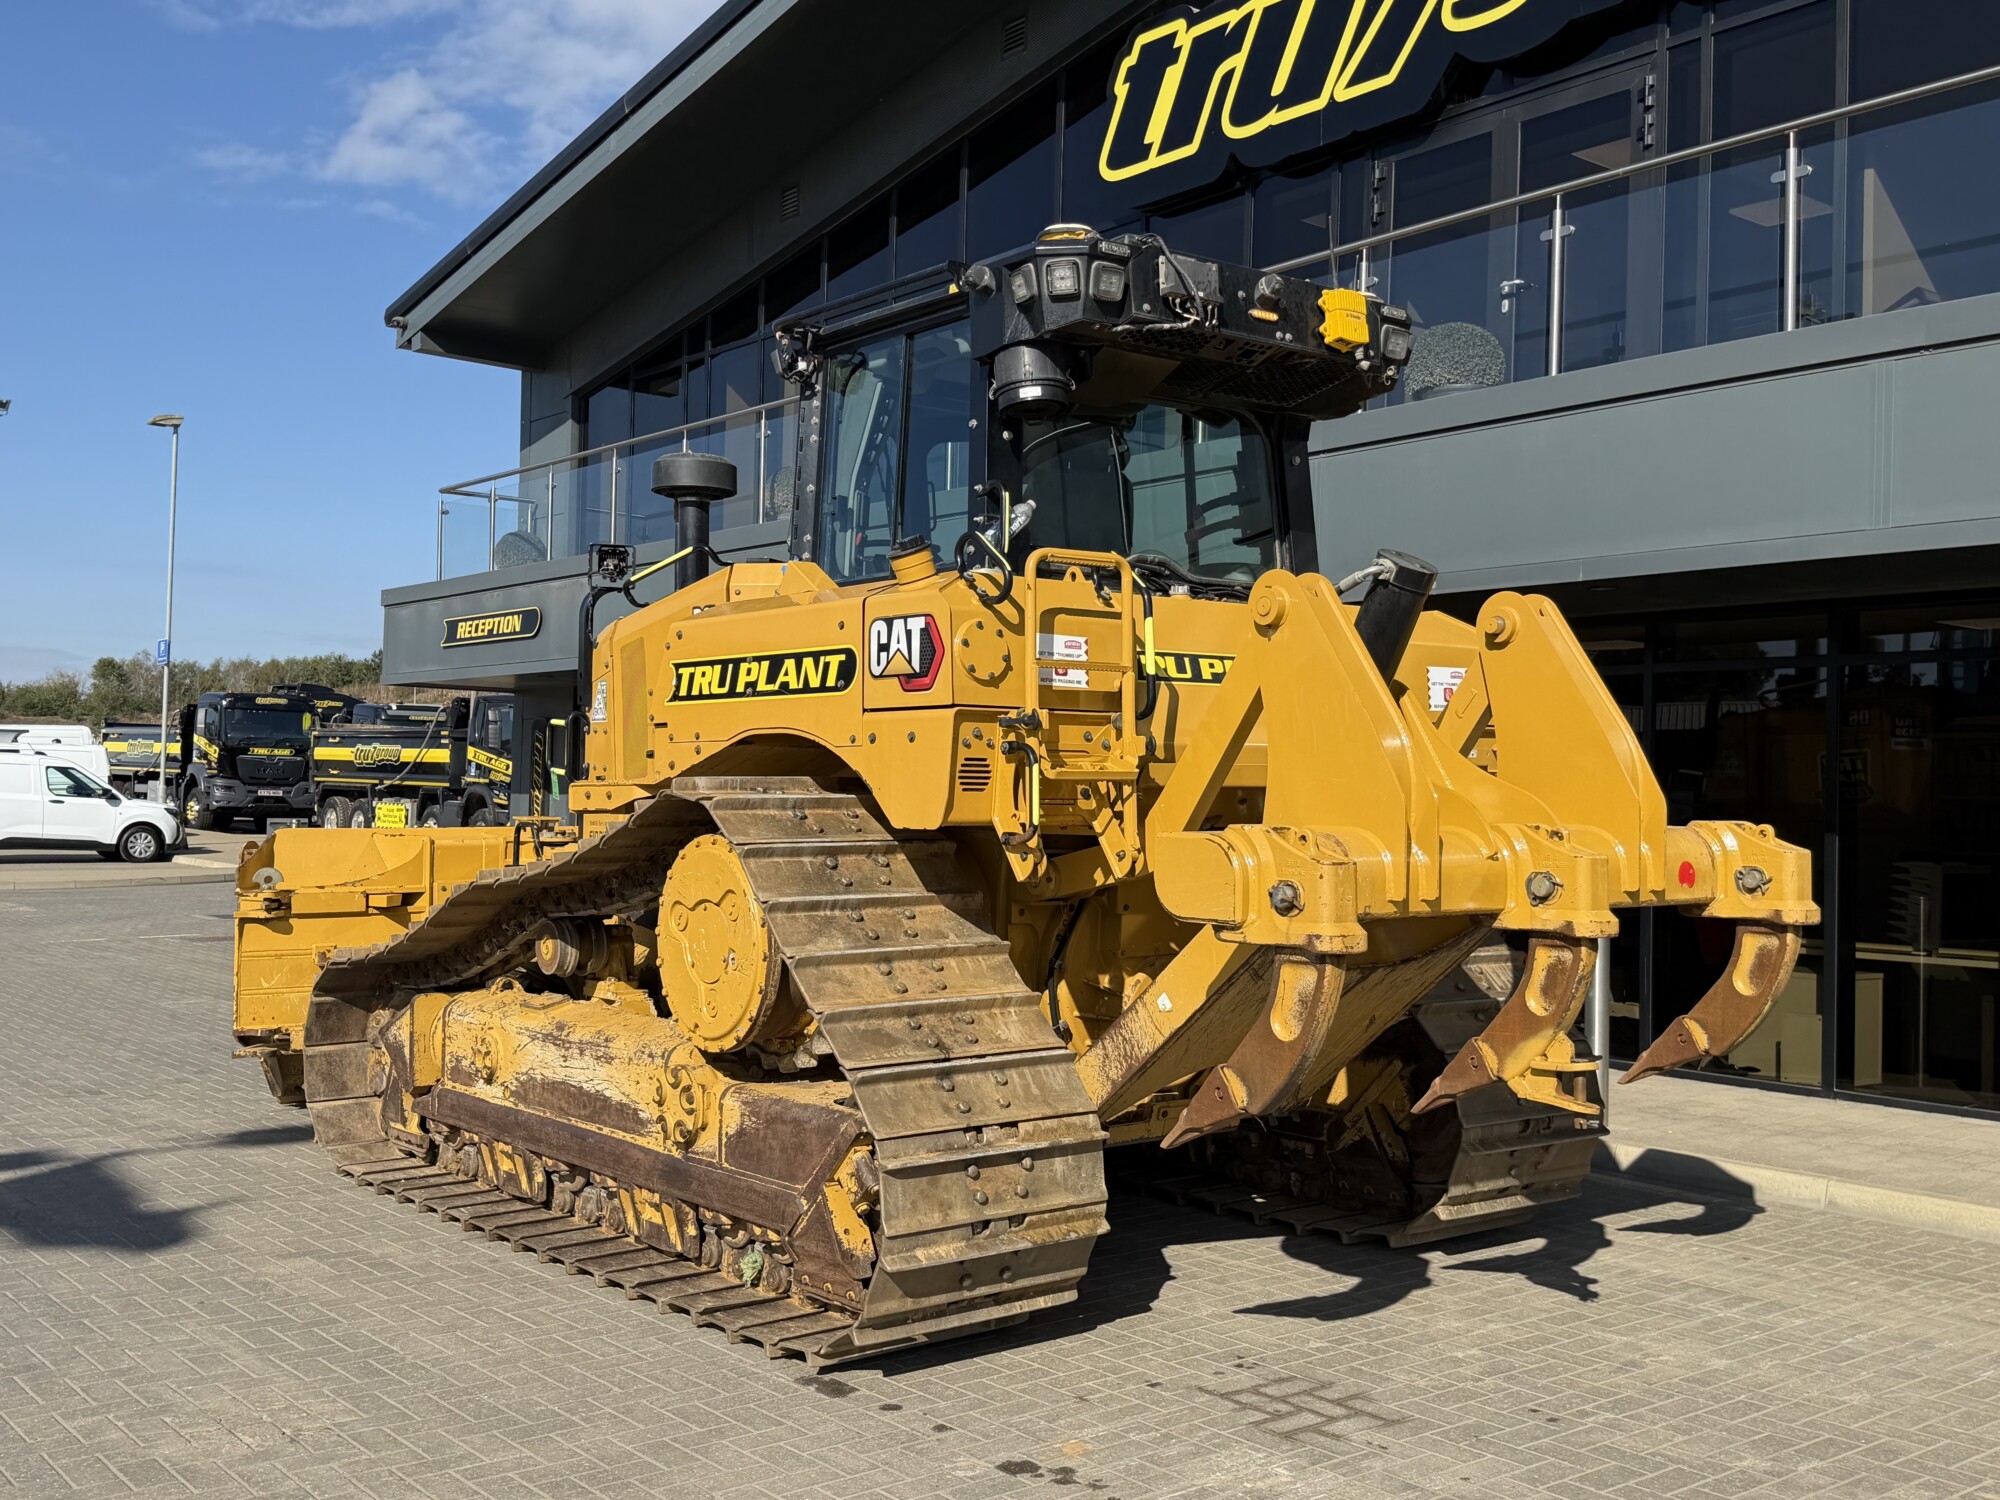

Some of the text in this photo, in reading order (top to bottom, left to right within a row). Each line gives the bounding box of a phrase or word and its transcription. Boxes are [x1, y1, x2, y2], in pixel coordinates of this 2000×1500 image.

[456, 614, 523, 639] RECEPTION
[870, 616, 926, 676] CAT
[678, 654, 846, 697] TRU PLANT
[475, 751, 490, 764] TRU
